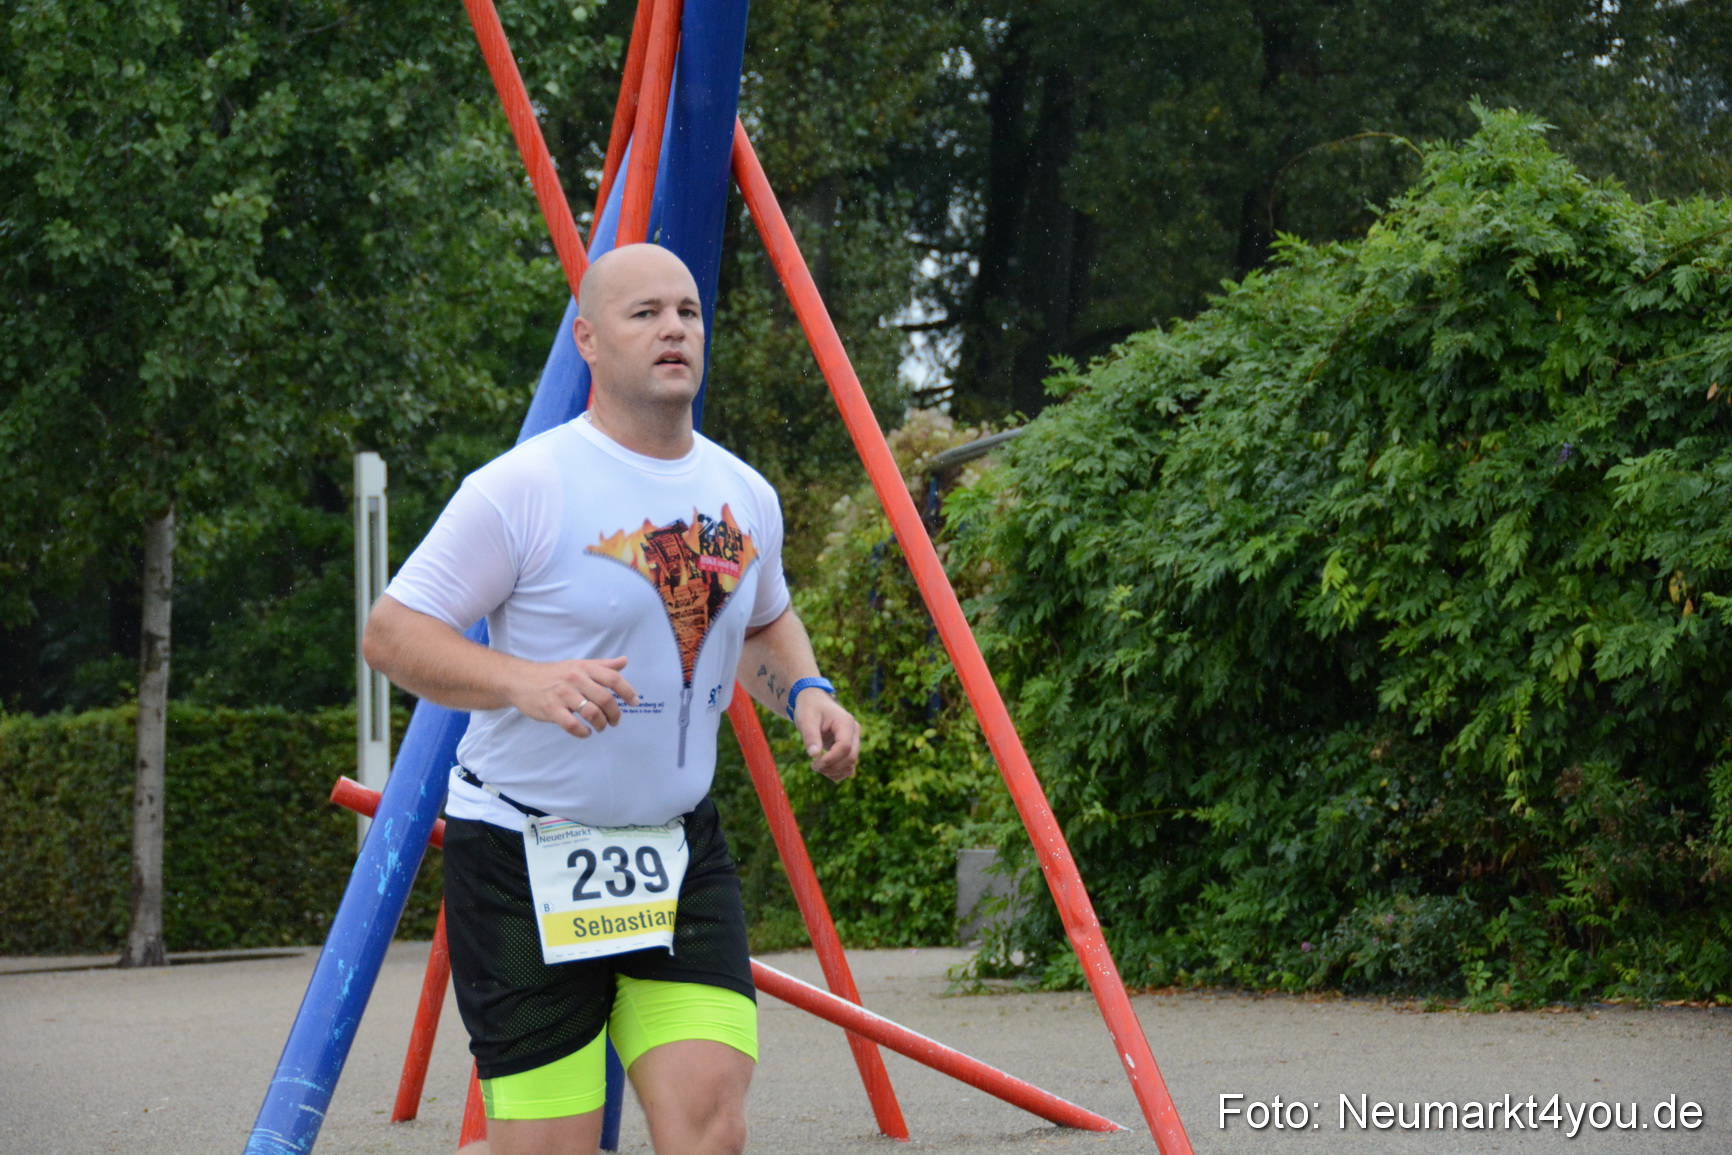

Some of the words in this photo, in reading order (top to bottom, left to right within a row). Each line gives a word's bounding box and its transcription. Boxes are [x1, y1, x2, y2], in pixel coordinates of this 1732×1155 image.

[539, 828, 592, 843] NeuerMarkt
[567, 846, 670, 901] 239
[543, 903, 551, 912] B
[573, 909, 676, 938] Sebastian
